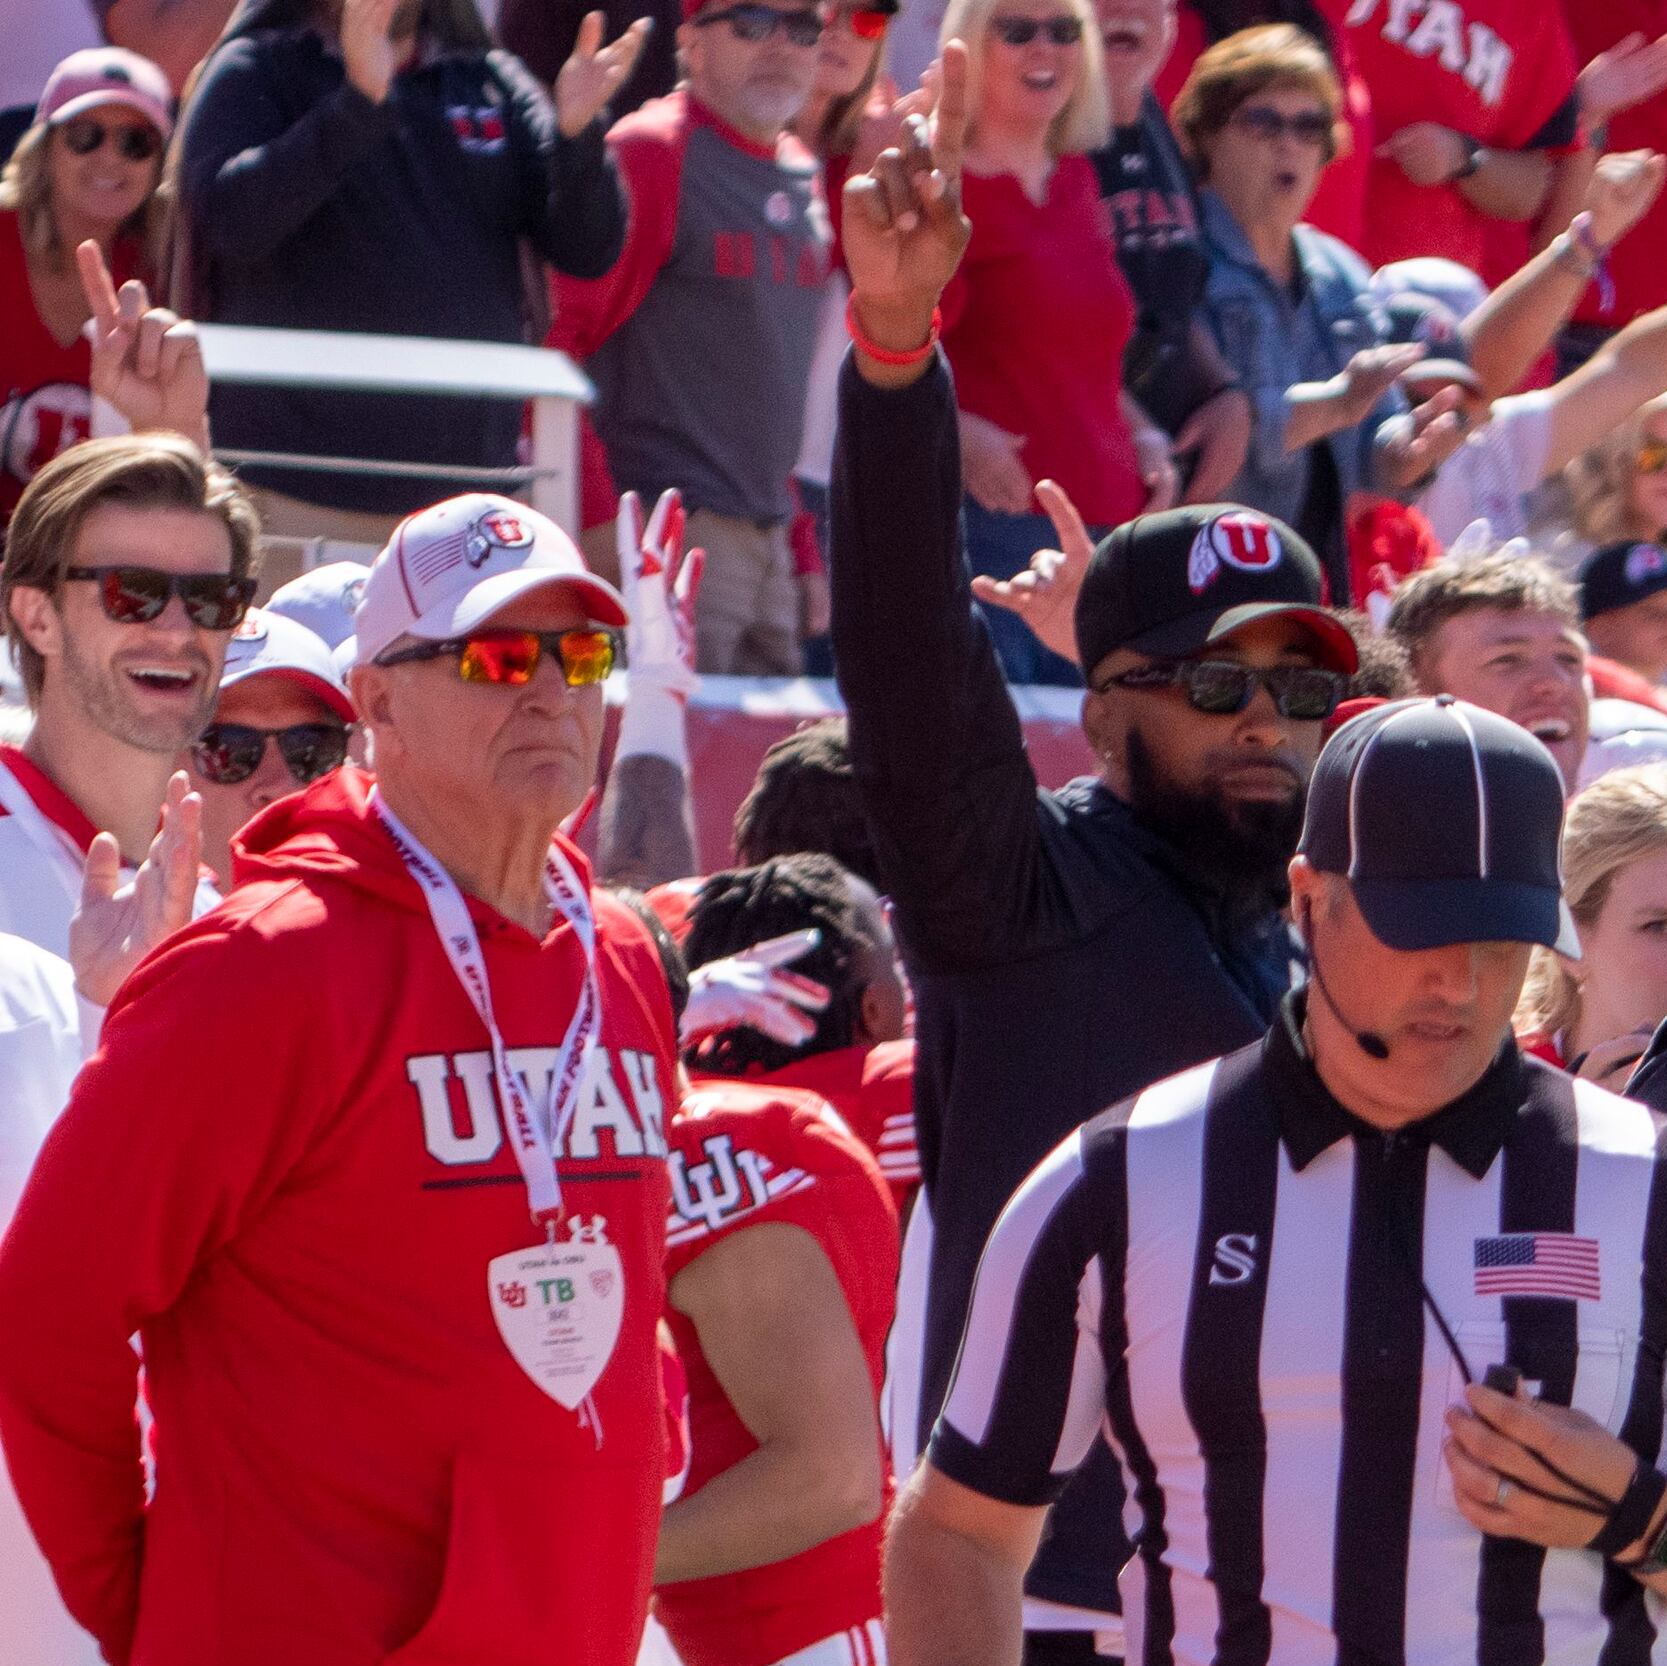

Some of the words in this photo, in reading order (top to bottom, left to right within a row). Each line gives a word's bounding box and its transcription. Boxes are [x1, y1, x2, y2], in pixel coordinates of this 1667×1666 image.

[1345, 0, 1514, 107] TAH
[1219, 518, 1270, 565] U
[405, 1045, 670, 1168] UTAH
[1209, 1233, 1257, 1285] S
[535, 1278, 575, 1305] TB
